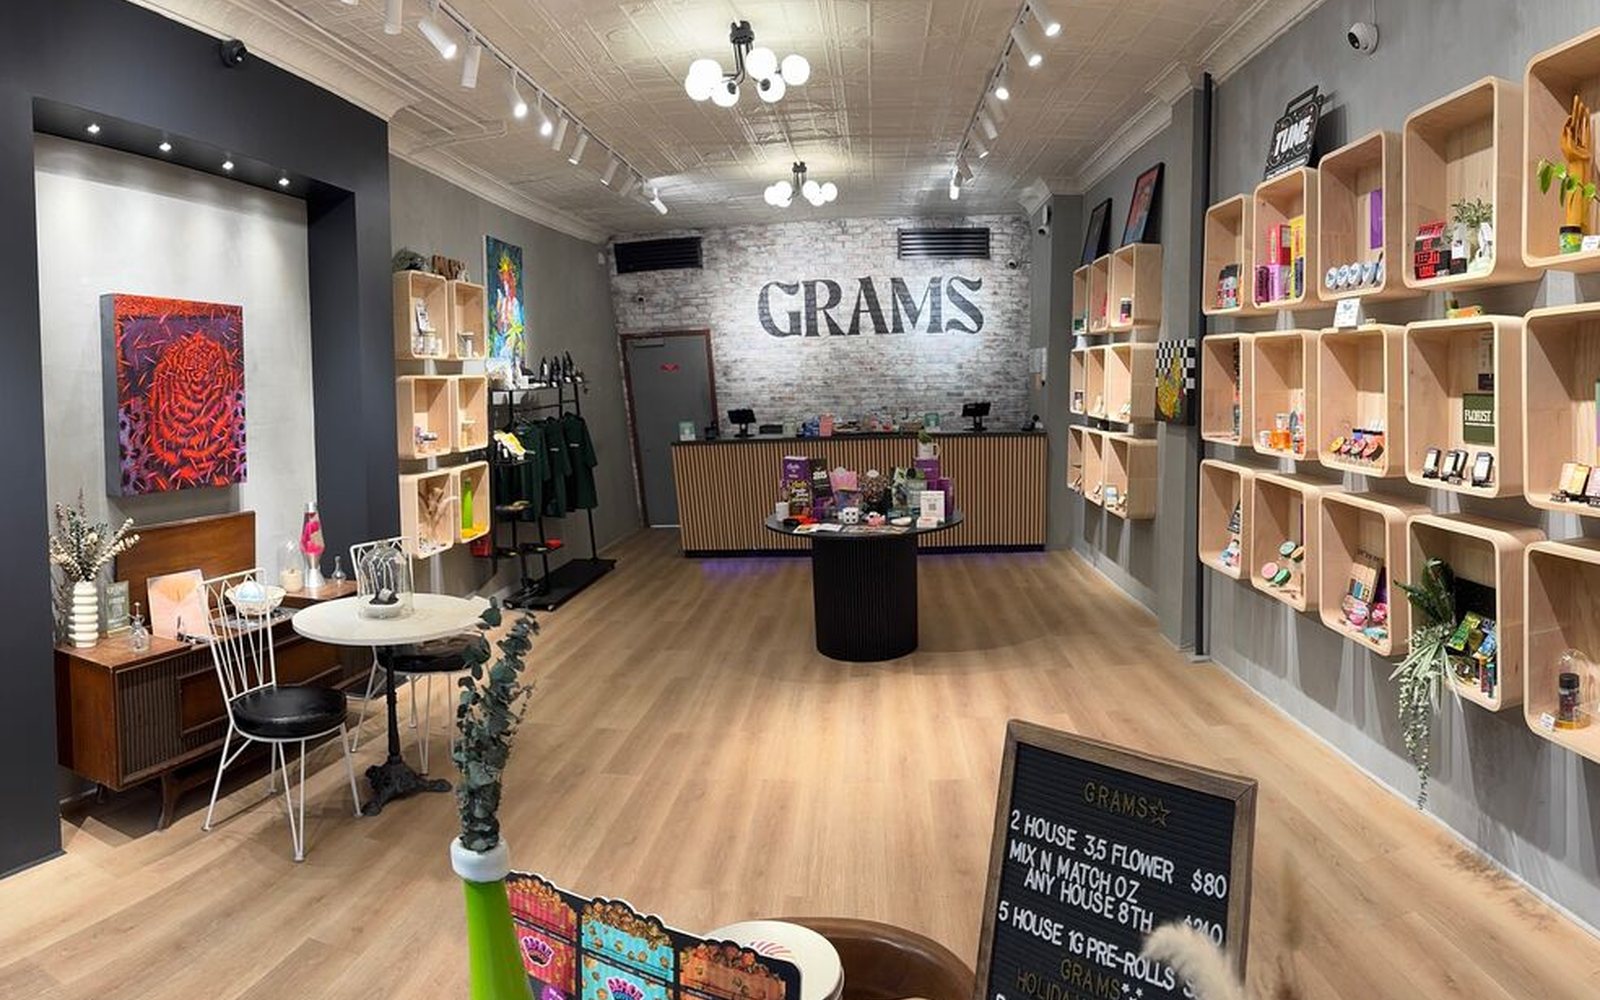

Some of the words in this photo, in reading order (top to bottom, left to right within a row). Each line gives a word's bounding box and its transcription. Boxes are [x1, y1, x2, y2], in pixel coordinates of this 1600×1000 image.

[1273, 114, 1313, 158] TUNE
[757, 275, 984, 338] GRAMS
[1084, 782, 1147, 818] GRAMS
[1009, 839, 1037, 868] MIX
[1040, 849, 1053, 873] N
[1056, 854, 1112, 895] MATCH
[1114, 876, 1141, 904] OZ
[1010, 809, 1021, 831] 2
[1023, 814, 1078, 851] HOUSE
[1111, 844, 1175, 884] FLOWER
[1190, 868, 1227, 899] $80
[1023, 867, 1056, 896] ANY
[1060, 880, 1115, 919] HOUSE
[1117, 901, 1154, 934] 8TH
[998, 900, 1010, 922] 5
[1012, 906, 1065, 946] HOUSE
[1067, 929, 1085, 955] 1G
[1085, 936, 1176, 991] PRE-ROLLS
[1060, 958, 1122, 1000] GRAMS
